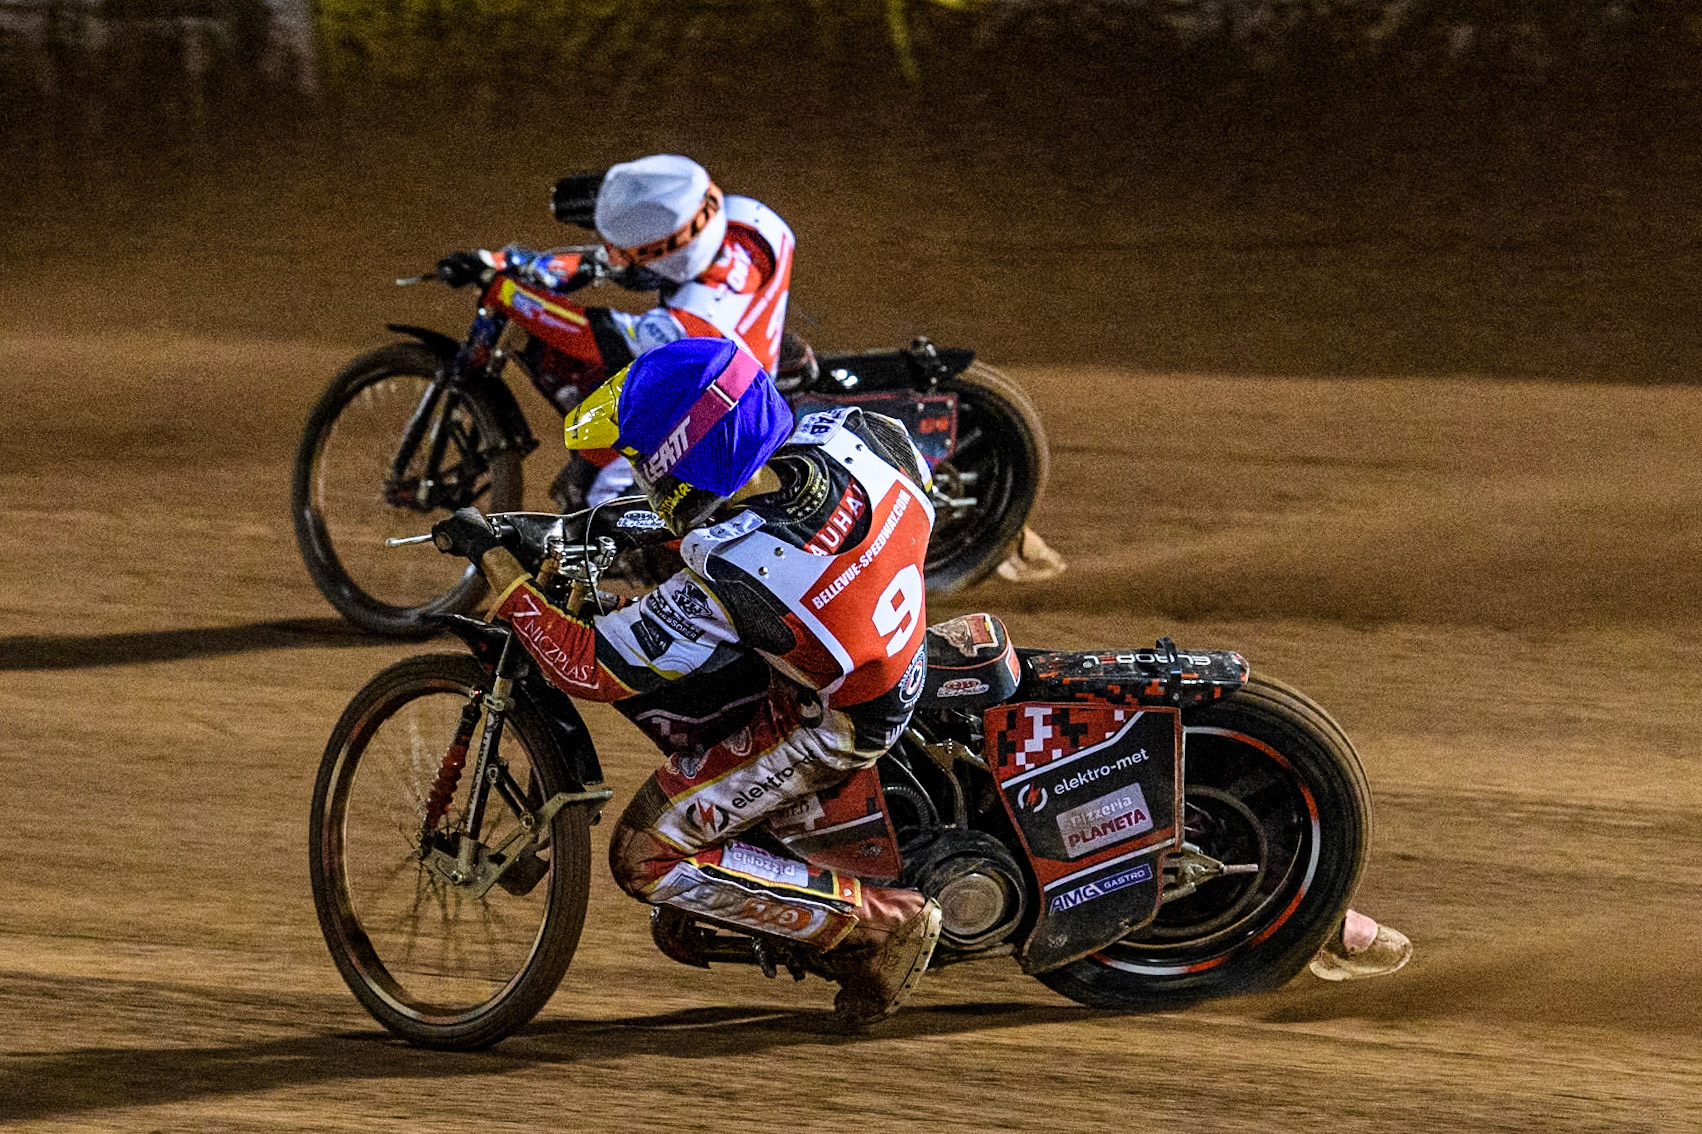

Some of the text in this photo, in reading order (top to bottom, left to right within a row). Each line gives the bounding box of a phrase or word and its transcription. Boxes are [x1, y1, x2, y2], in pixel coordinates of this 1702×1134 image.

[643, 415, 691, 483] LEATT
[811, 488, 912, 610] BELLEVUE-SPEEDWAY.COM
[871, 562, 923, 658] 9
[1053, 747, 1150, 796] elektro-met
[1067, 808, 1148, 849] PLANETA
[1050, 869, 1146, 913] AMG GASTRO
